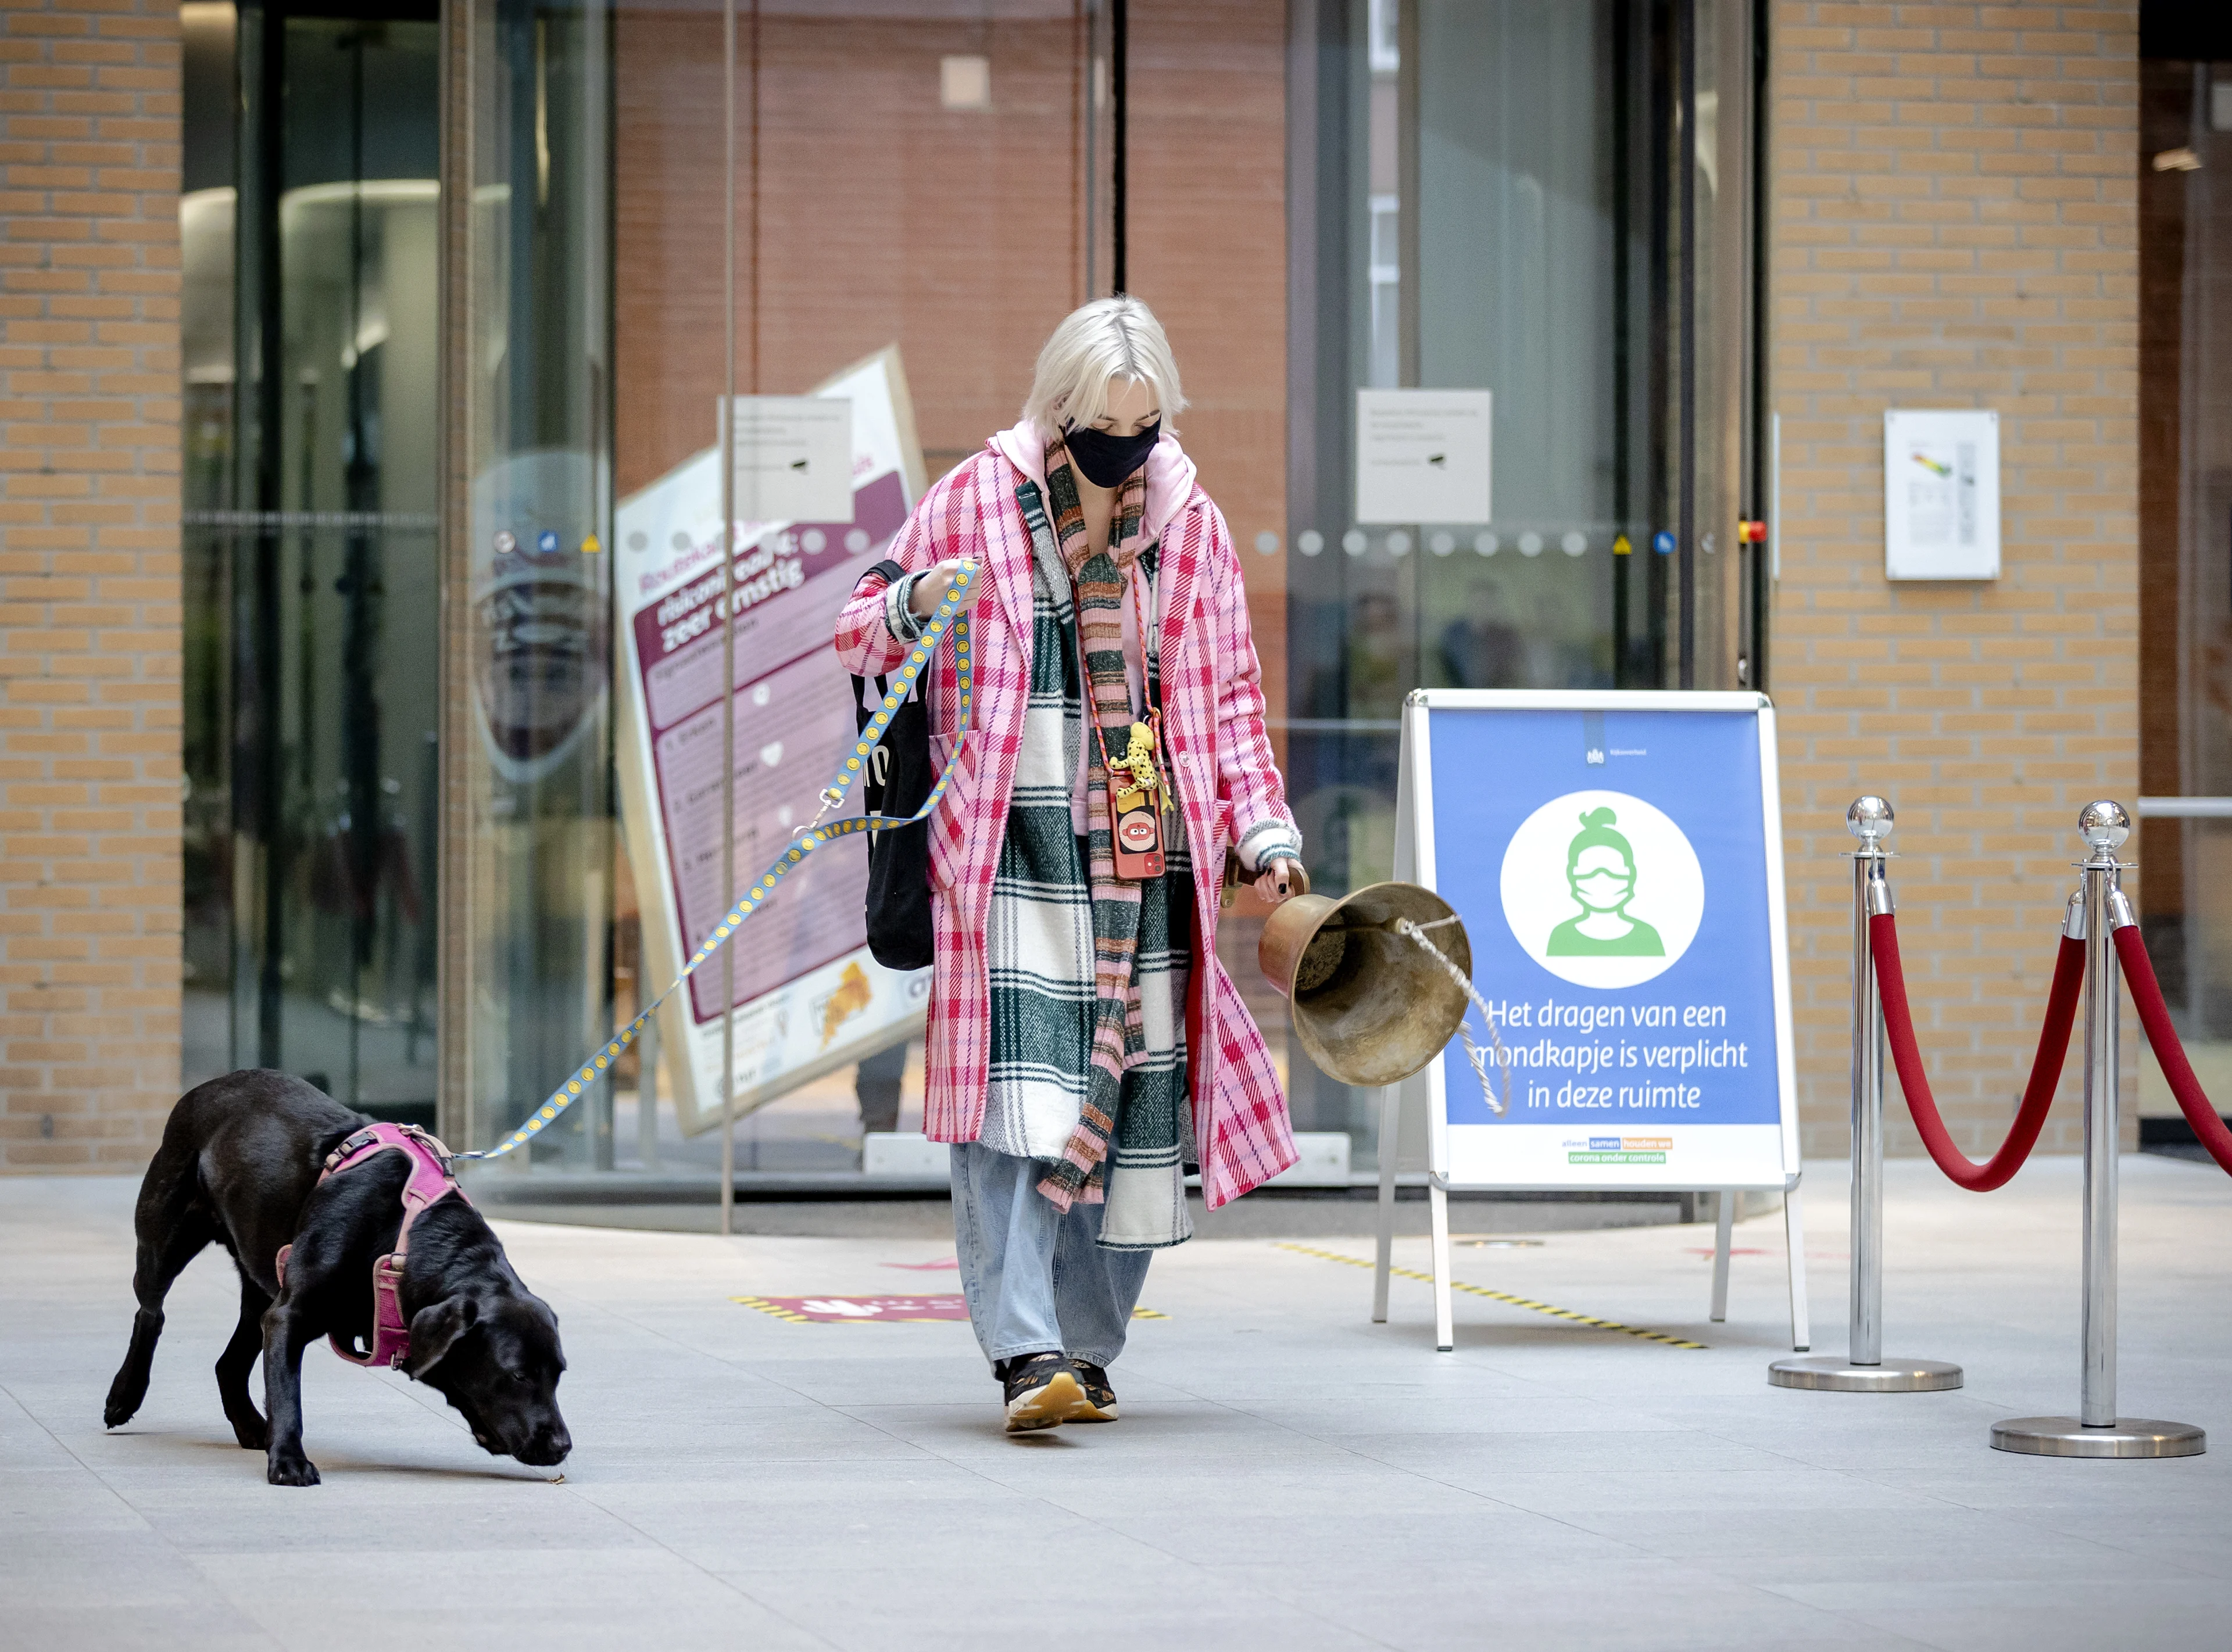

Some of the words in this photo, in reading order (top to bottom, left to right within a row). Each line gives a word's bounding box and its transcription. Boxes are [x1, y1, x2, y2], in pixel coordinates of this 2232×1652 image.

[661, 604, 713, 652] zeer
[1488, 999, 1532, 1027] Het
[1537, 998, 1625, 1034] dragen
[1631, 1005, 1676, 1027] van
[1683, 1005, 1726, 1027] een
[1471, 1038, 1614, 1074] mondkapje
[1620, 1039, 1637, 1067] is
[1643, 1038, 1748, 1074] verplicht
[1528, 1080, 1550, 1108] in
[1557, 1079, 1612, 1108] deze
[1619, 1080, 1701, 1108] ruimte
[1562, 1139, 1587, 1147] alleen
[1623, 1139, 1657, 1148] houden
[1570, 1153, 1600, 1162] corona
[1601, 1153, 1627, 1162] onder
[1628, 1153, 1664, 1162] controle
